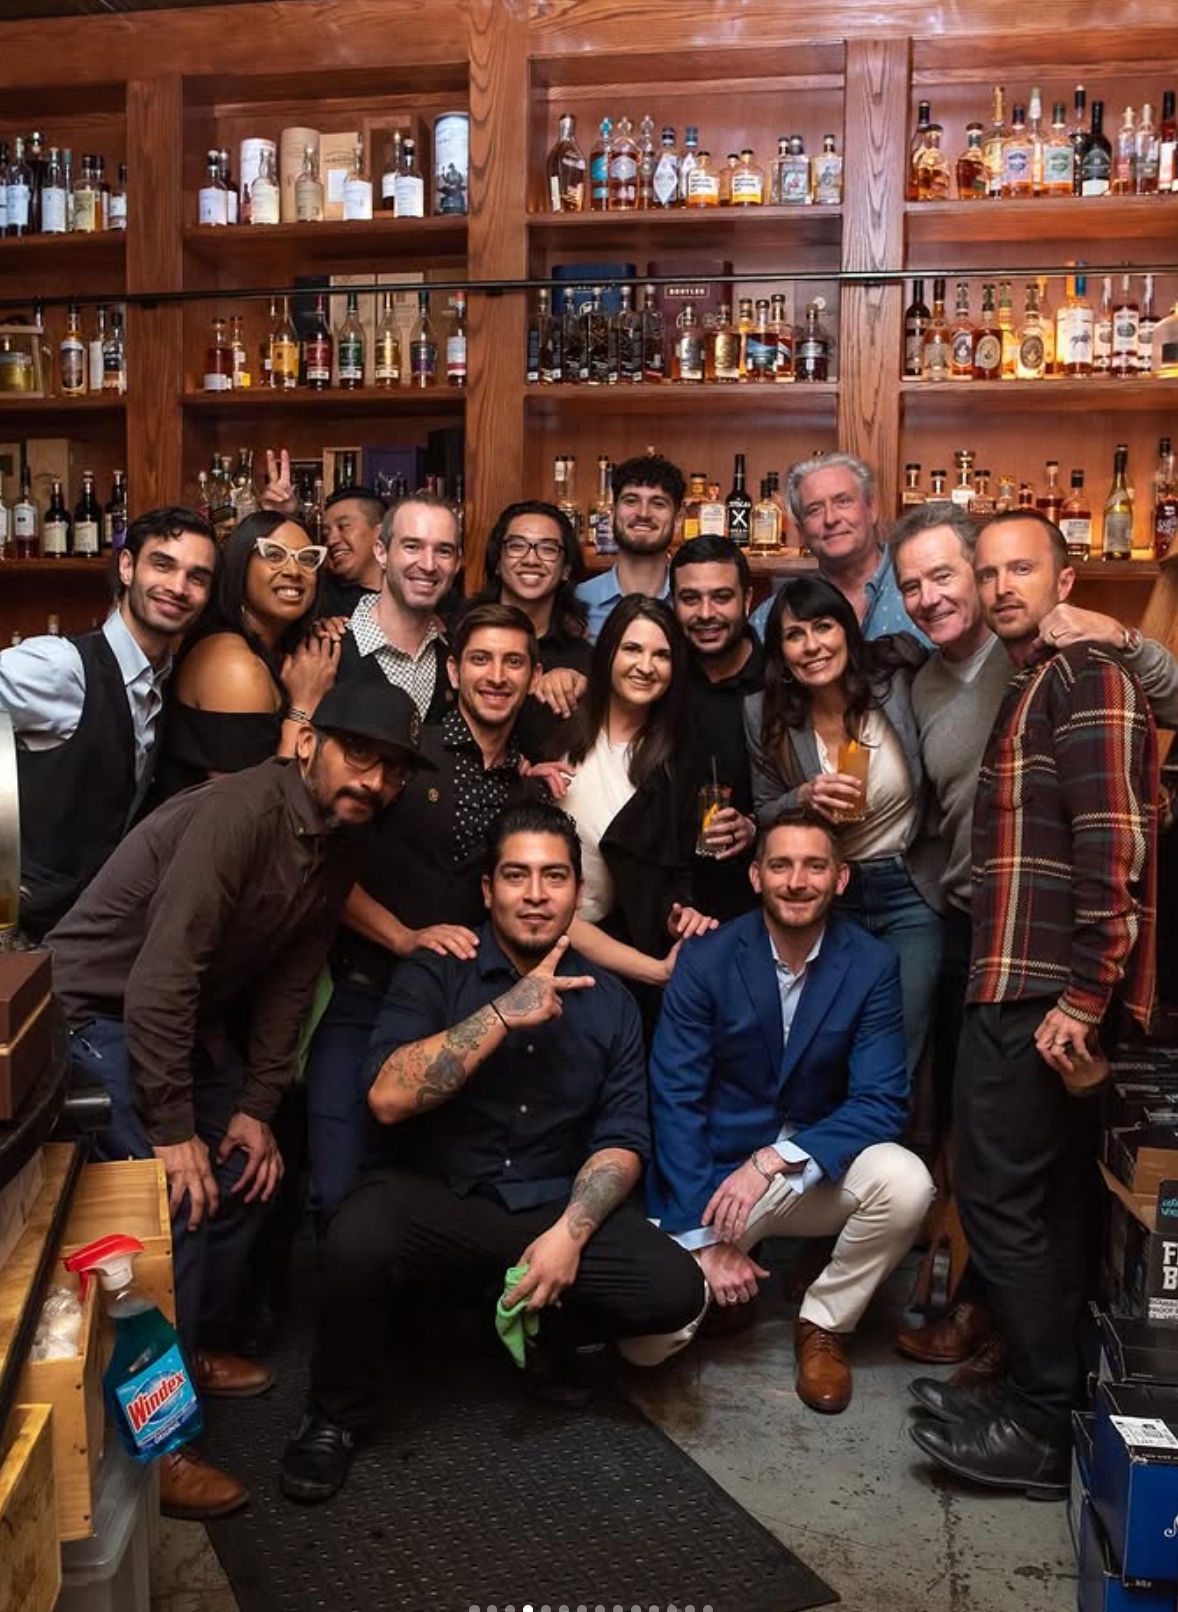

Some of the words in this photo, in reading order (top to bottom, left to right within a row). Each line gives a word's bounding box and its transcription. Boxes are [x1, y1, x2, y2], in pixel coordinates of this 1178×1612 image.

[732, 509, 748, 528] X
[1162, 1241, 1178, 1265] F
[126, 1370, 186, 1434] Windex
